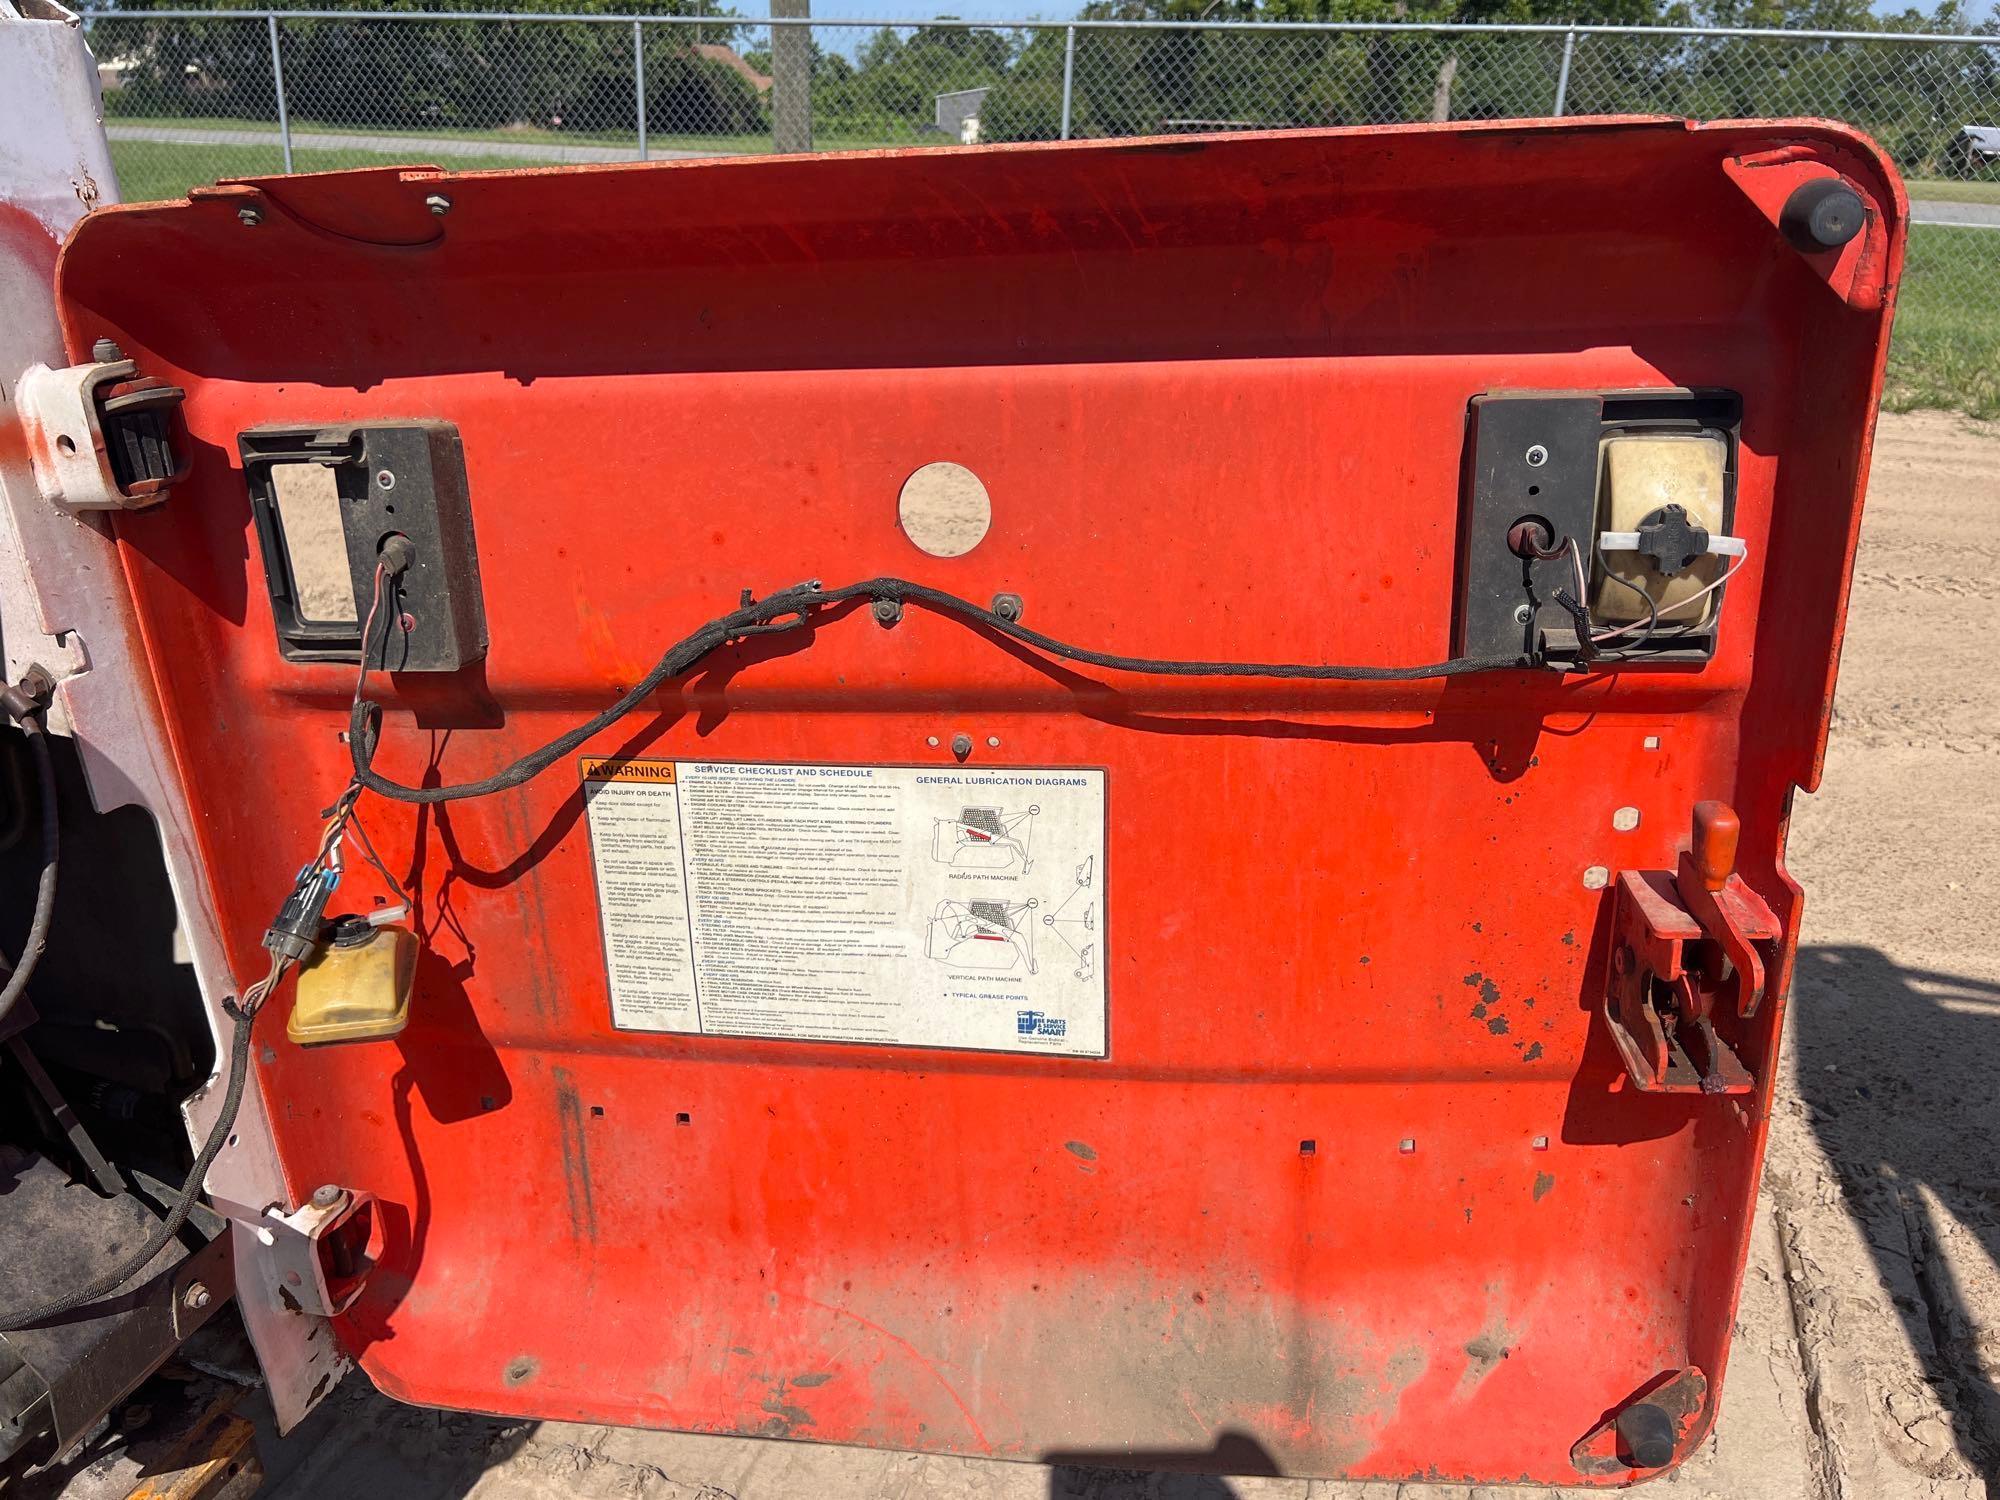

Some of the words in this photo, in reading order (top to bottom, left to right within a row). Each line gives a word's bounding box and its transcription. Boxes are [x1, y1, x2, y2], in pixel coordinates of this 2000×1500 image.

[601, 765, 671, 778] WARNING
[694, 765, 736, 774] SERVICE
[738, 766, 793, 776] CHECKLIST
[819, 769, 872, 777] SCHEDULE
[916, 776, 963, 784] GENERAL
[966, 778, 1033, 786] LUBRICATION
[1035, 778, 1087, 786] DIAGRAMS
[1037, 1028, 1066, 1036] SMART
